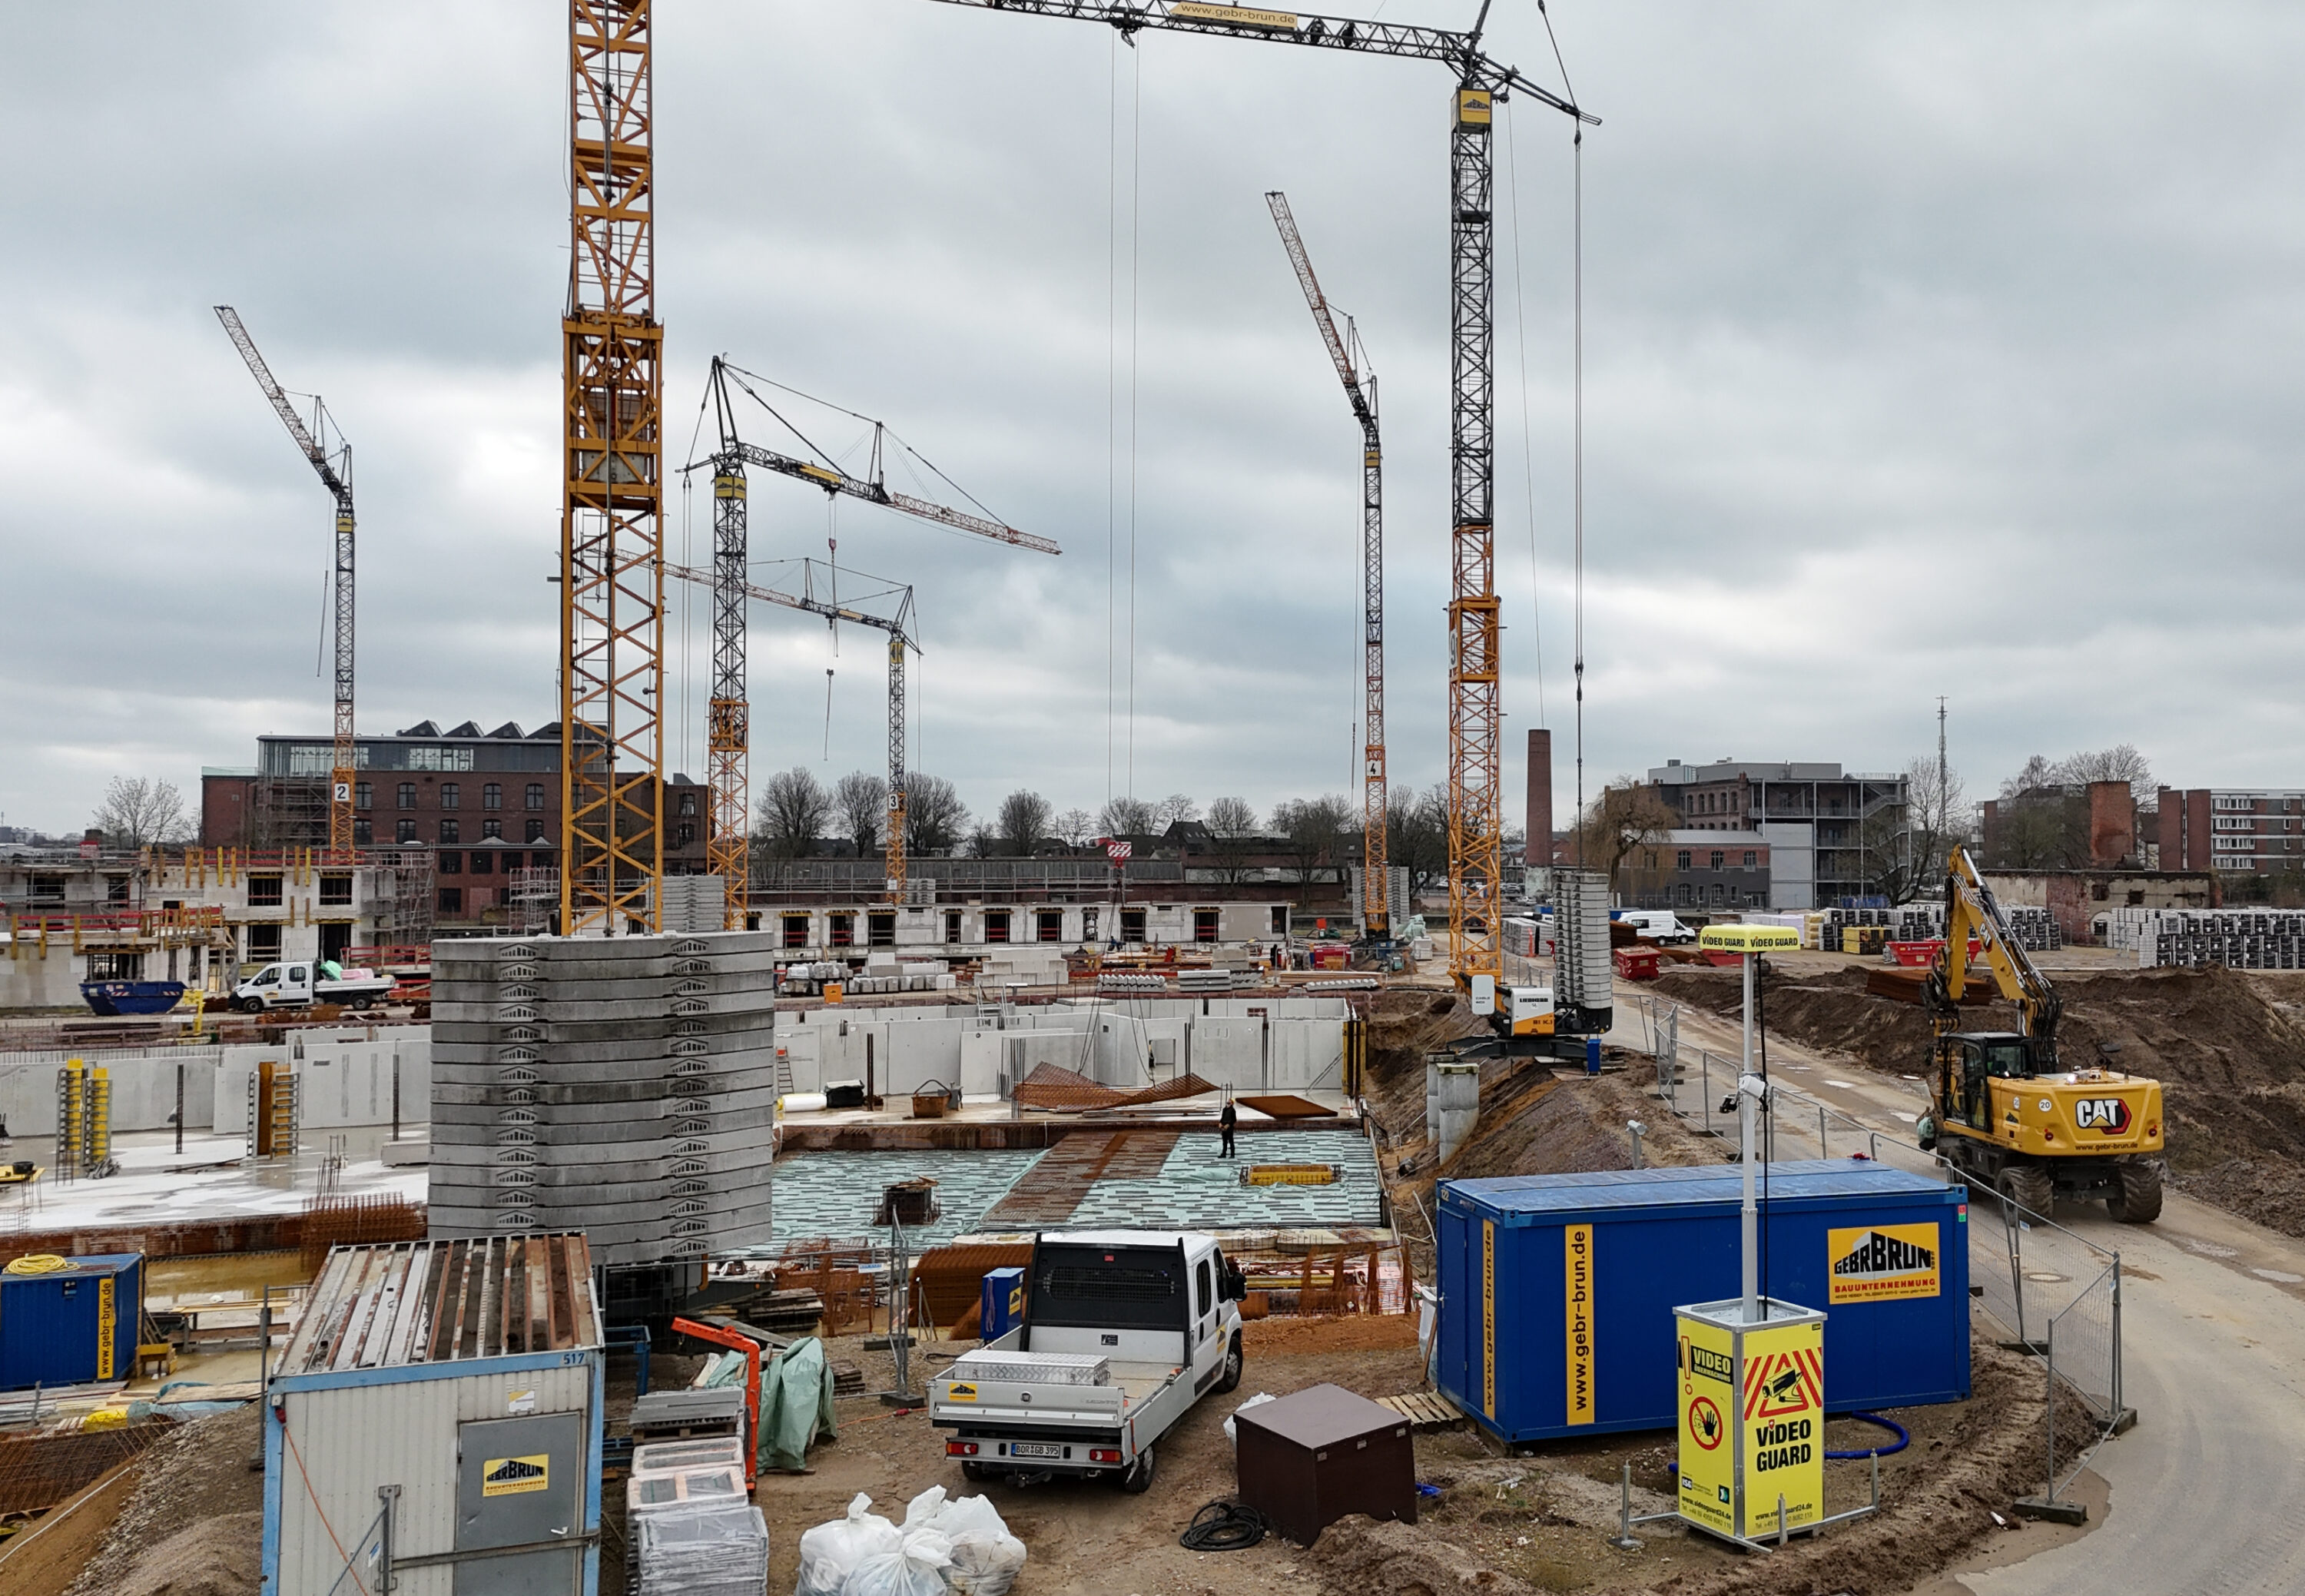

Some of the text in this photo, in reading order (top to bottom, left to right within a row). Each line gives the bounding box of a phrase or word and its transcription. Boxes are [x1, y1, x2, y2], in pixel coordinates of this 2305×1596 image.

[1181, 4, 1295, 24] www.gebr-brun.de
[1370, 762, 1376, 775] 4
[337, 785, 347, 799] 2
[890, 795, 897, 807] 3
[1724, 937, 1745, 947] GUARD
[1775, 937, 1798, 947] GUARD
[1979, 923, 1992, 947] CAT
[2077, 1100, 2118, 1128] CAT
[2075, 1142, 2138, 1151] www.gebr-brun.de
[1835, 1279, 1935, 1292] BAUUNTERNEHMUNG
[1484, 1229, 1493, 1405] www.gebr-brun.de
[1571, 1231, 1590, 1411] www.gebr-brun.de
[101, 1283, 111, 1375] www.gebr-brun.de
[563, 1353, 585, 1365] 517
[1693, 1348, 1731, 1375] VIDEO
[1016, 1445, 1059, 1455] BOR GB 395
[1756, 1443, 1812, 1472] GUARD
[1682, 1495, 1732, 1521] www.videoguard24.de
